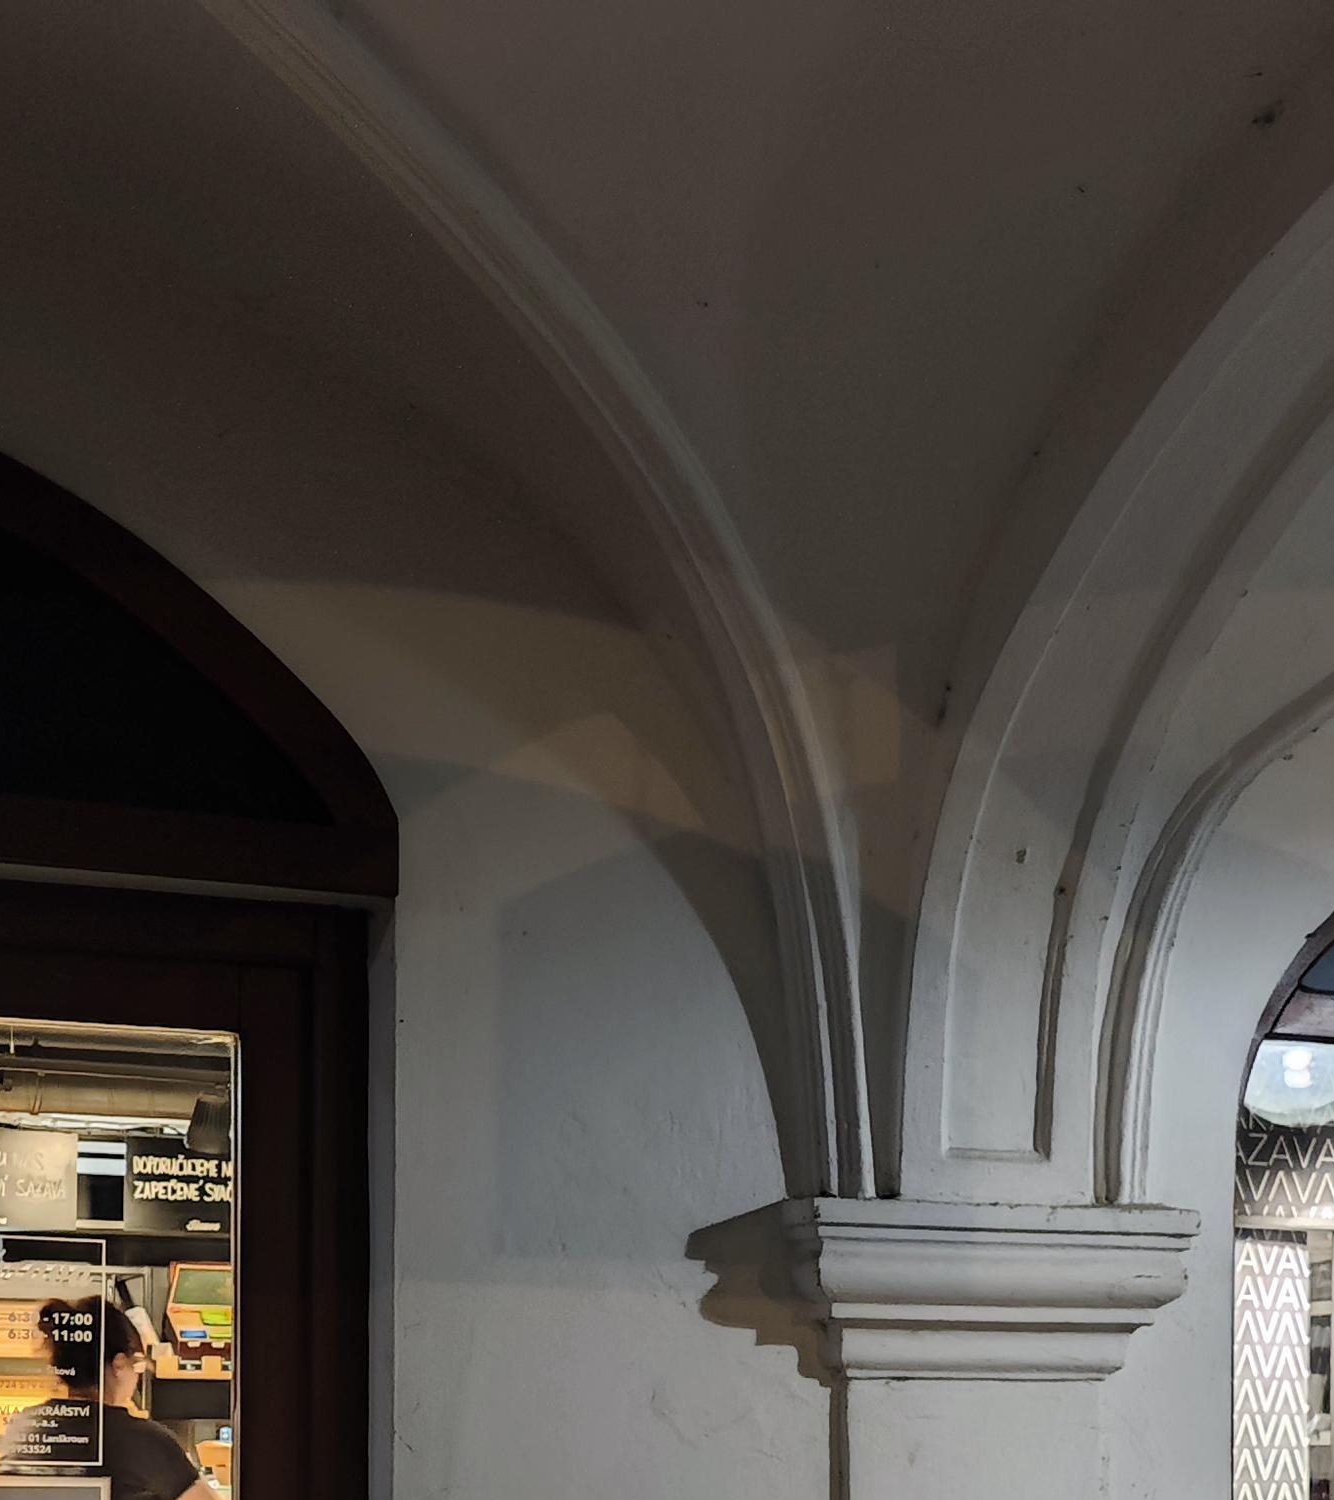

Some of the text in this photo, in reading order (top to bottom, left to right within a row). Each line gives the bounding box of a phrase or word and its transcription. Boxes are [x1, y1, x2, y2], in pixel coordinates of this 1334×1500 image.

[132, 1178, 202, 1202] ZAPEČENÉ
[52, 1312, 94, 1326] 17:00
[52, 1329, 94, 1343] 11:00
